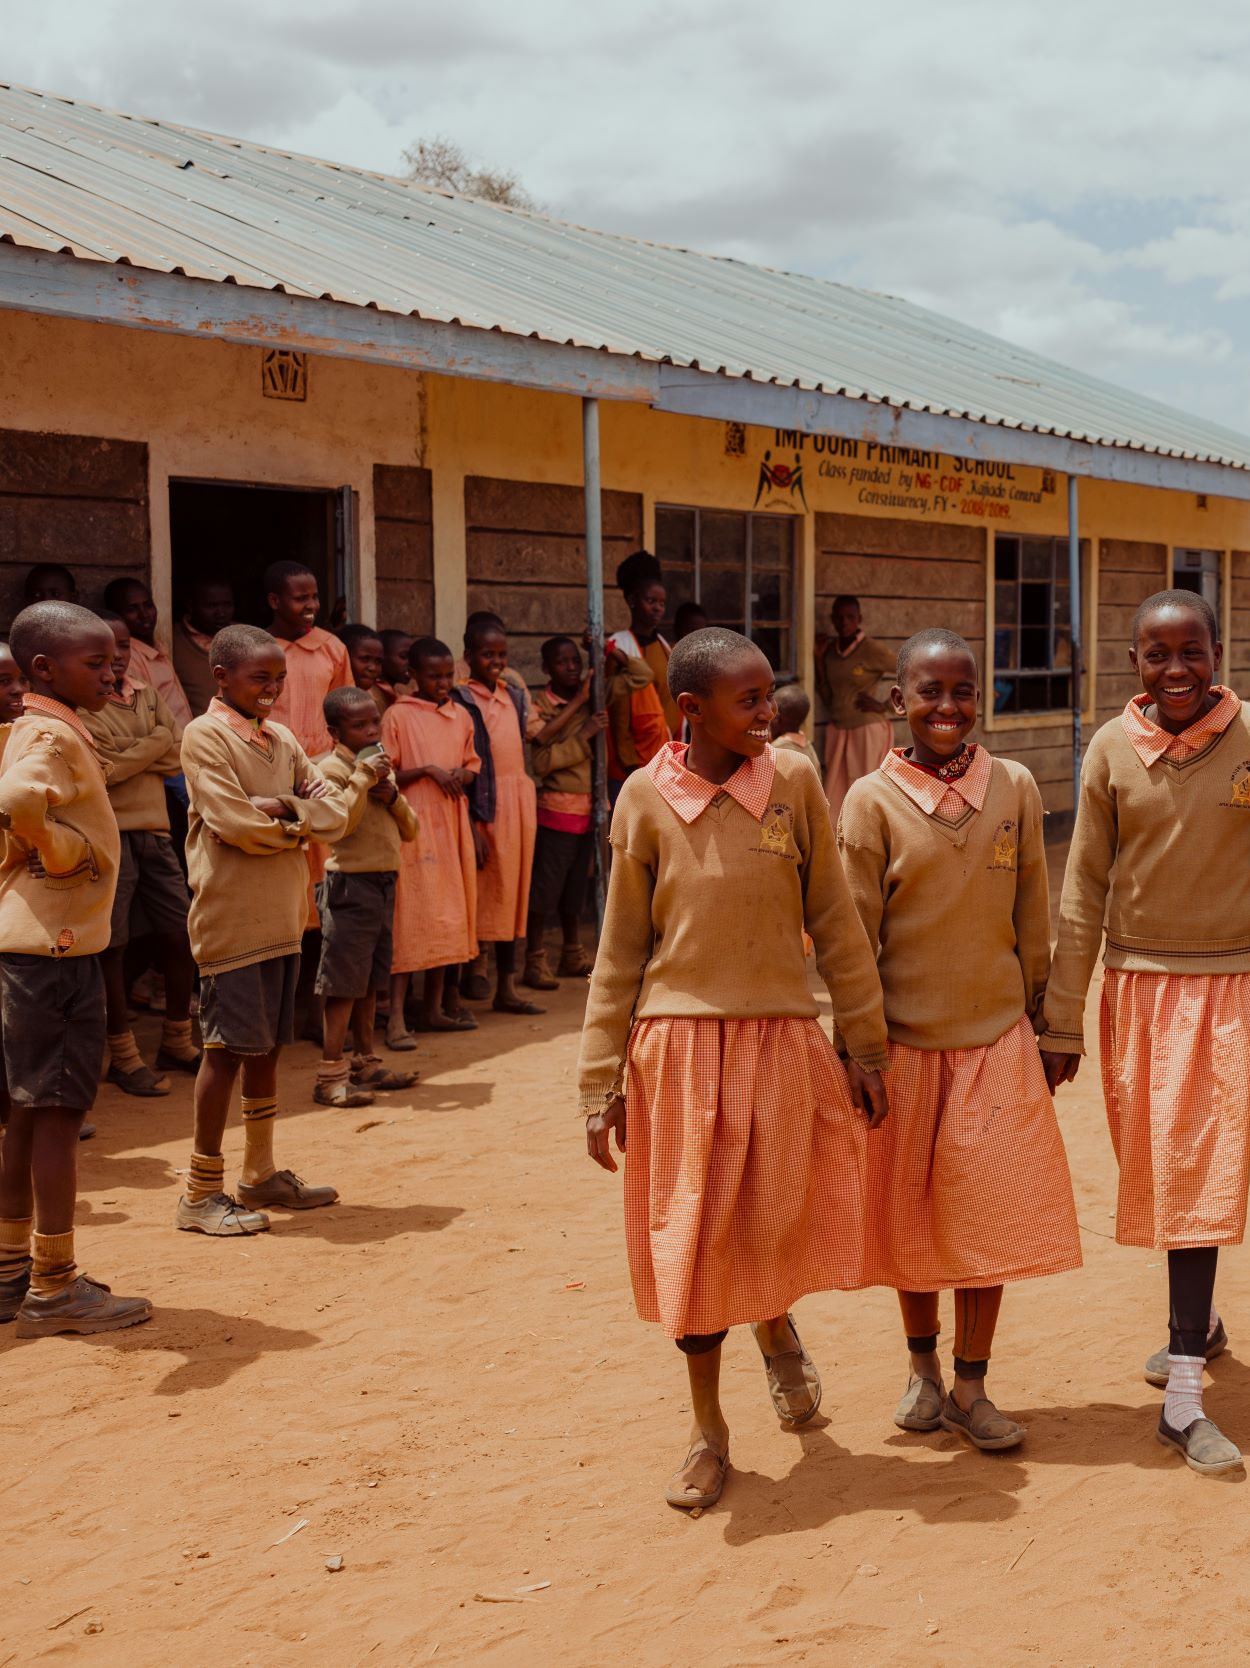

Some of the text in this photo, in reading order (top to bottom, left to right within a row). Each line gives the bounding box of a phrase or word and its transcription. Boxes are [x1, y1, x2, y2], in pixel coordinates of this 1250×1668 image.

[818, 459, 847, 479] Class
[848, 467, 893, 486] funded
[897, 470, 914, 493] by
[933, 495, 950, 512] FY
